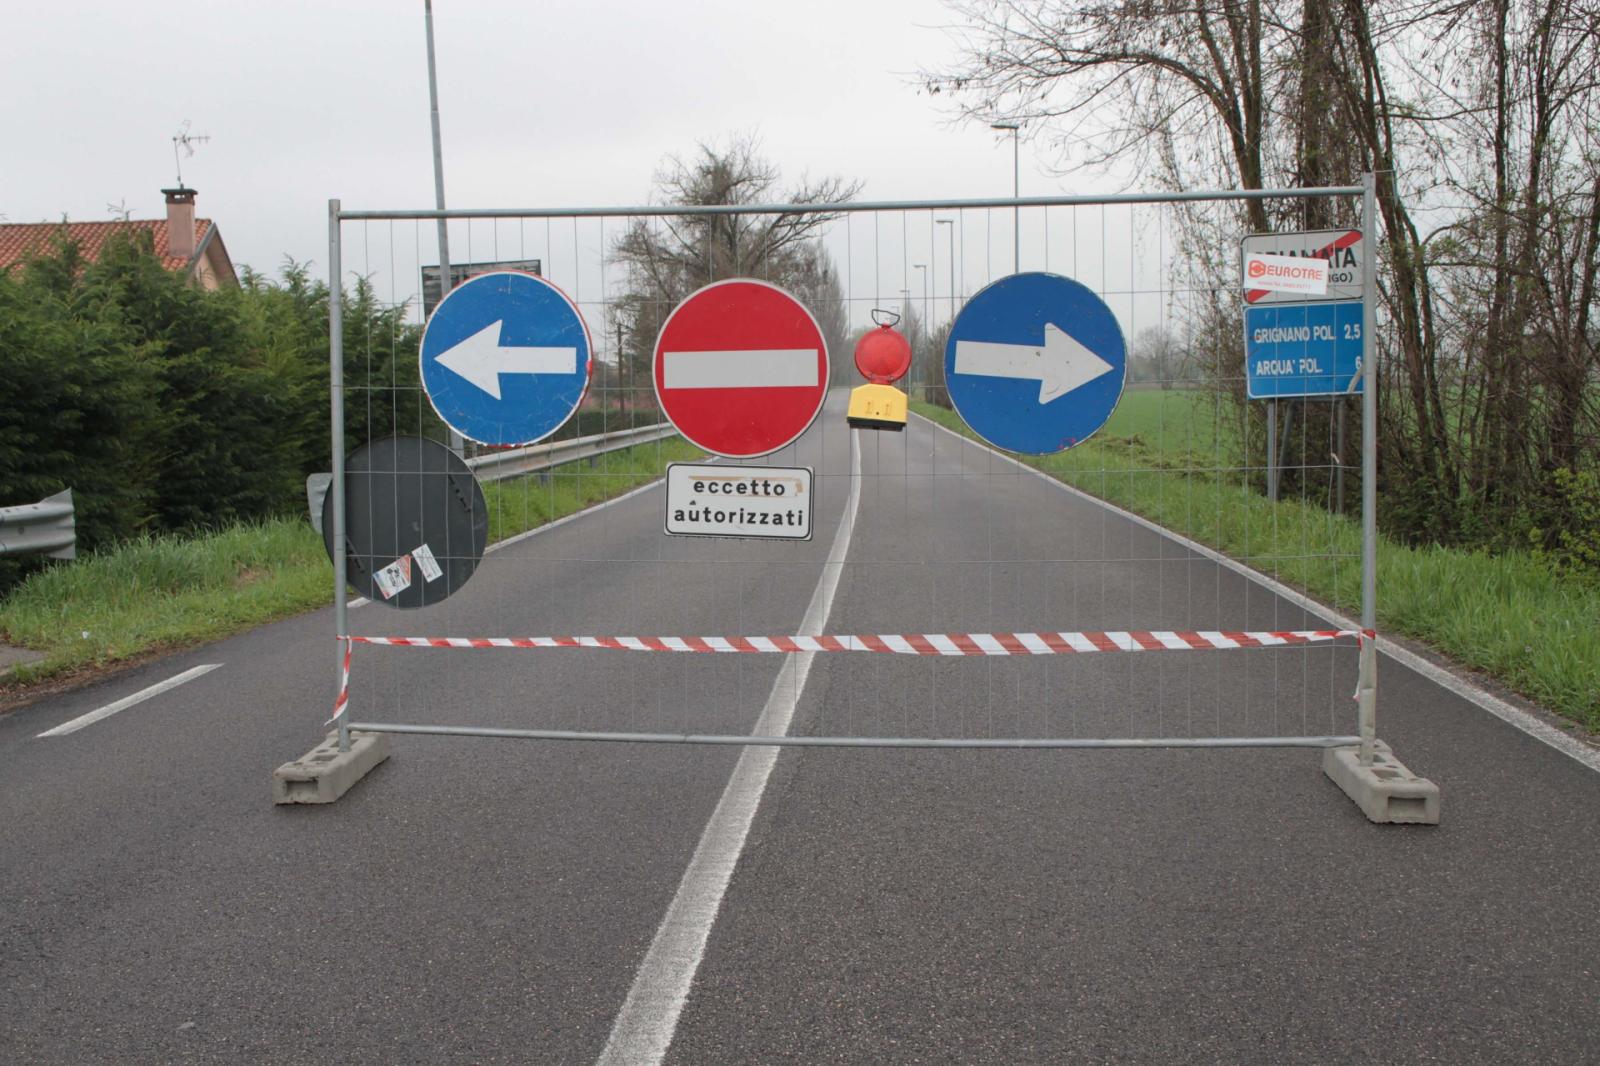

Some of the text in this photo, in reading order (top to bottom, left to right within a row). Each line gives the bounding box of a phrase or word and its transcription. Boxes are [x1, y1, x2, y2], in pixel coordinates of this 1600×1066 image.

[1268, 265, 1323, 281] EUROTRE
[1254, 326, 1310, 344] GRIGNANO
[1344, 323, 1361, 340] 2,5
[1299, 358, 1323, 374] POL.
[693, 479, 786, 497] eccetto
[674, 506, 803, 526] autorizzati
